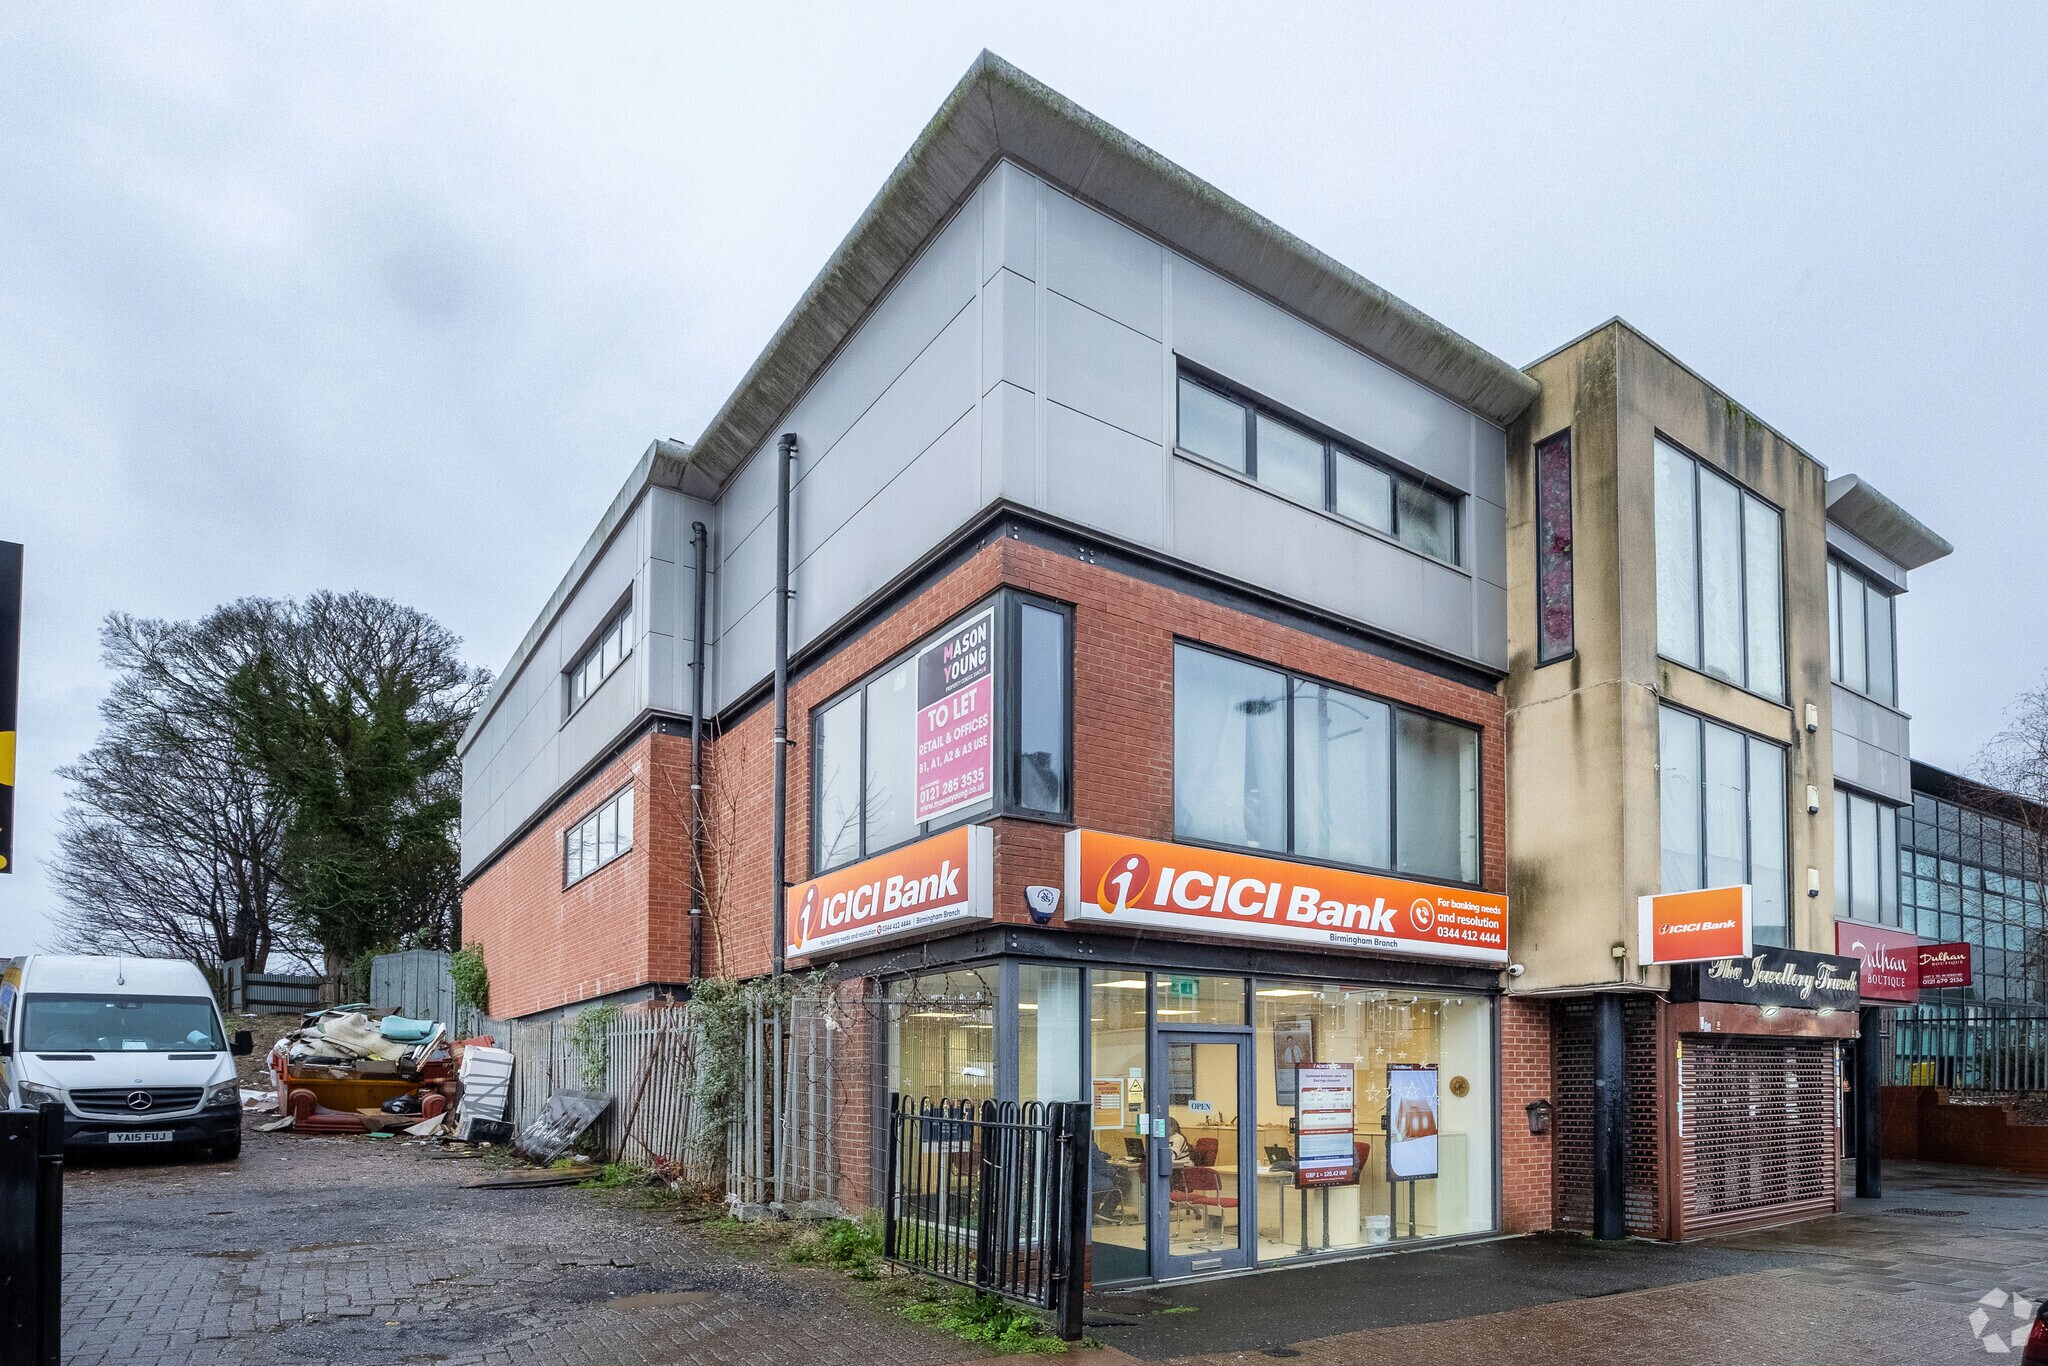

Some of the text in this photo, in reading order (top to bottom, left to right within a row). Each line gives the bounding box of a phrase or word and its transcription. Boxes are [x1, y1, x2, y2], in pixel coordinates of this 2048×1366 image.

[943, 622, 987, 664] MASON
[944, 645, 987, 684] YOUNG
[928, 687, 977, 732] TO LET
[919, 713, 988, 756] RETAIL & OFFICES
[930, 756, 942, 769] A1,
[943, 750, 953, 764] A2
[955, 747, 960, 758] &
[962, 742, 972, 756] A3
[973, 735, 988, 750] USE
[920, 785, 940, 804] 0121
[942, 777, 959, 796] 285
[961, 766, 984, 788] 3535
[920, 782, 985, 813] www.masonyoung.co.uk
[820, 881, 880, 930] ICICI
[883, 860, 961, 913] Bank
[1153, 867, 1282, 919] ICICI
[1285, 885, 1398, 933] Bank
[1437, 897, 1501, 915] For banking needs
[916, 908, 960, 925] Birmingham Branch
[1437, 912, 1499, 929] and resolution
[1669, 919, 1736, 934] ICICI Bank
[1329, 933, 1398, 947] Birmingham Branch
[1437, 926, 1501, 944] 0344 412 4444
[1919, 952, 1966, 966] Dulhan
[1708, 954, 1858, 1000] The Jewellery Trunk
[1867, 973, 1905, 988] BOUTIQUE
[1191, 1102, 1211, 1111] OPEN
[116, 1132, 166, 1142] YA15 FUJ
